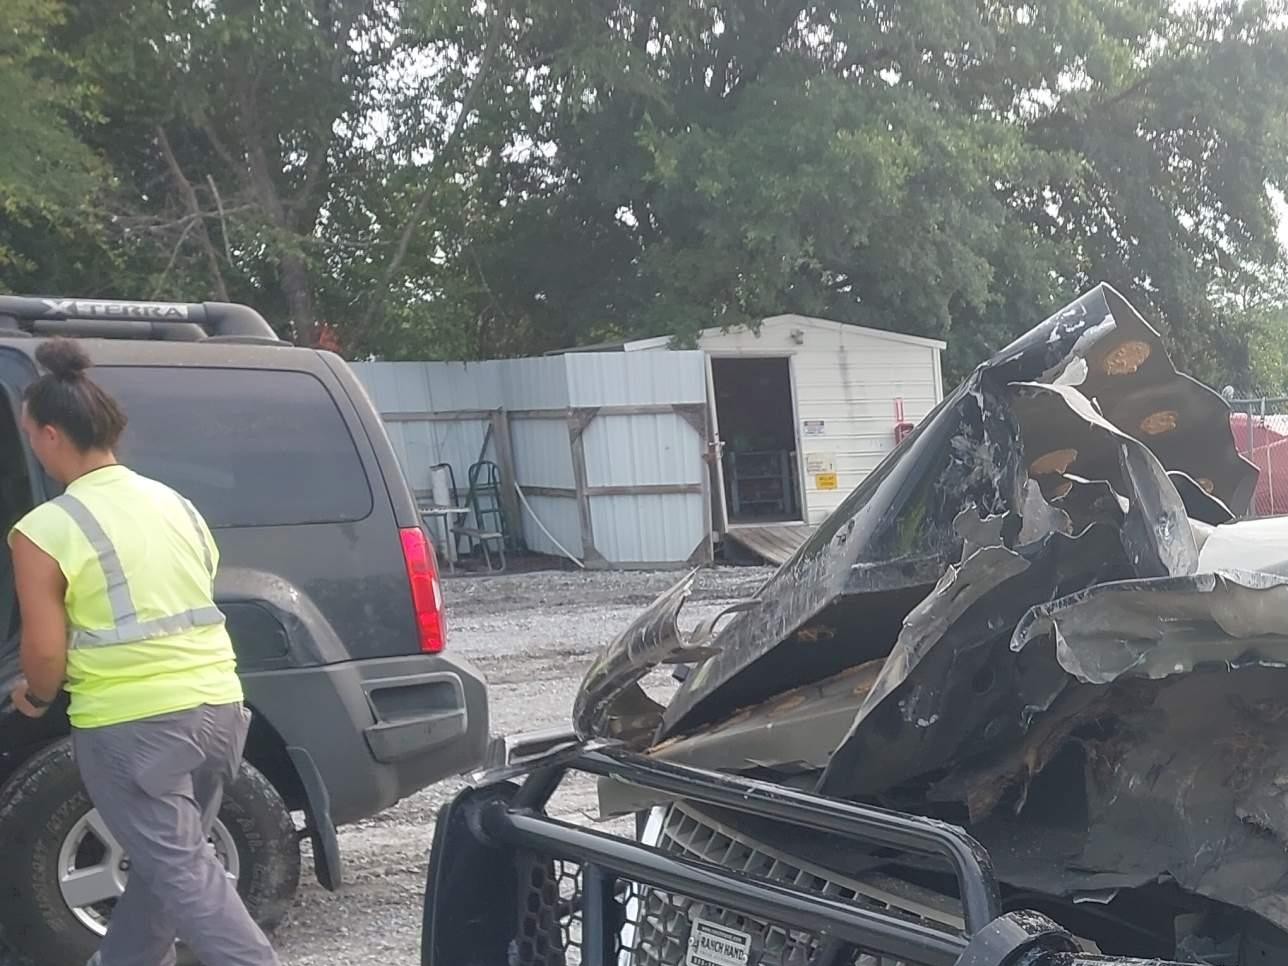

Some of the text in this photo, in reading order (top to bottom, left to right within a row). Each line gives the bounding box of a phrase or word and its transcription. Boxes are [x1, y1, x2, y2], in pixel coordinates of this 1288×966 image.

[41, 298, 184, 317] XTERRA
[701, 936, 723, 954] RANCH
[725, 944, 744, 961] HAND
